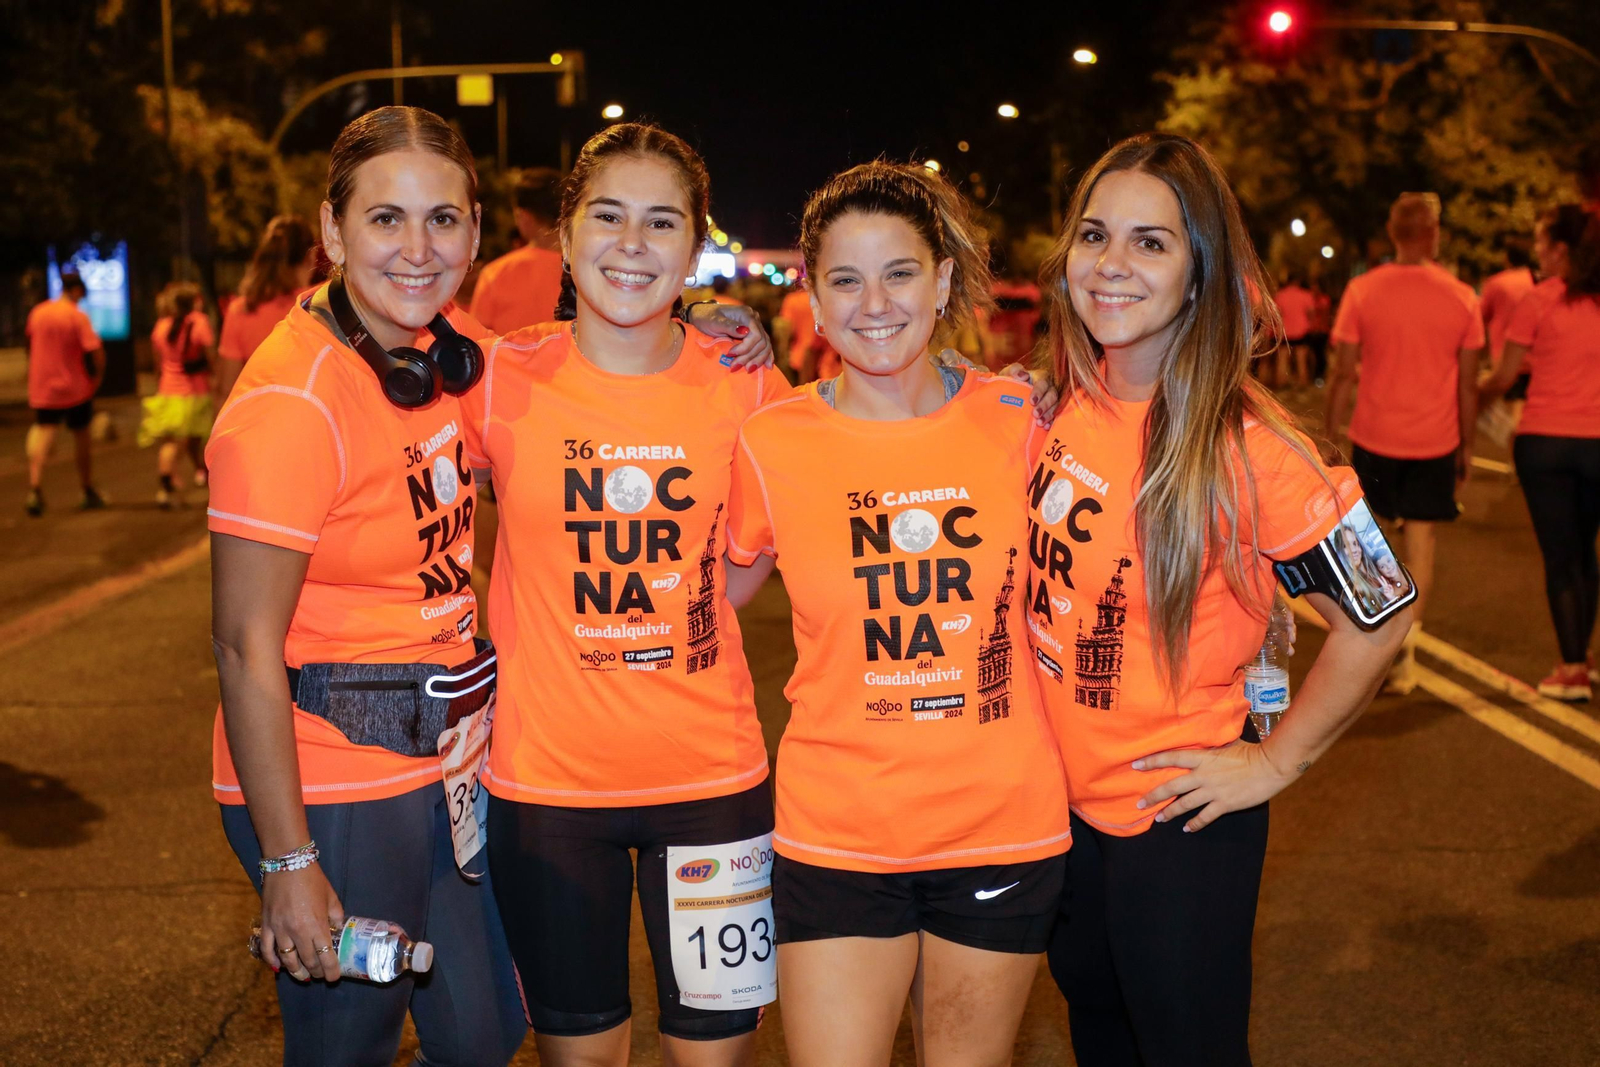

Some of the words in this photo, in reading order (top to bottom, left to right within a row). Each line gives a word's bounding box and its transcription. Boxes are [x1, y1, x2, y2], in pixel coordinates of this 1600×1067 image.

[404, 442, 422, 468] 36
[564, 440, 594, 460] 36
[598, 444, 686, 460] CARRERA
[1046, 438, 1066, 462] 36
[1061, 454, 1110, 496] CARRERA
[847, 490, 878, 510] 36
[882, 487, 970, 506] CARRERA
[418, 496, 474, 565] TUR
[565, 519, 682, 565] TUR
[1028, 516, 1076, 590] UR
[417, 554, 471, 600] NA
[854, 558, 974, 610] TUR
[574, 571, 656, 614] NA
[628, 614, 642, 623] del
[574, 622, 672, 640] Guadalquivir
[863, 613, 946, 662] NA
[628, 662, 656, 671] SEVILLA
[656, 661, 672, 670] 2024
[636, 649, 672, 662] septiembre
[918, 660, 932, 669] del
[864, 666, 962, 686] Guadalquivir
[913, 700, 922, 708] 27
[924, 696, 964, 709] septiembre
[914, 712, 943, 721] SEVILLA
[944, 709, 962, 718] 2024
[726, 894, 756, 904] NOCTURNA
[688, 917, 776, 970] 193
[684, 992, 722, 1000] Cruzcampo
